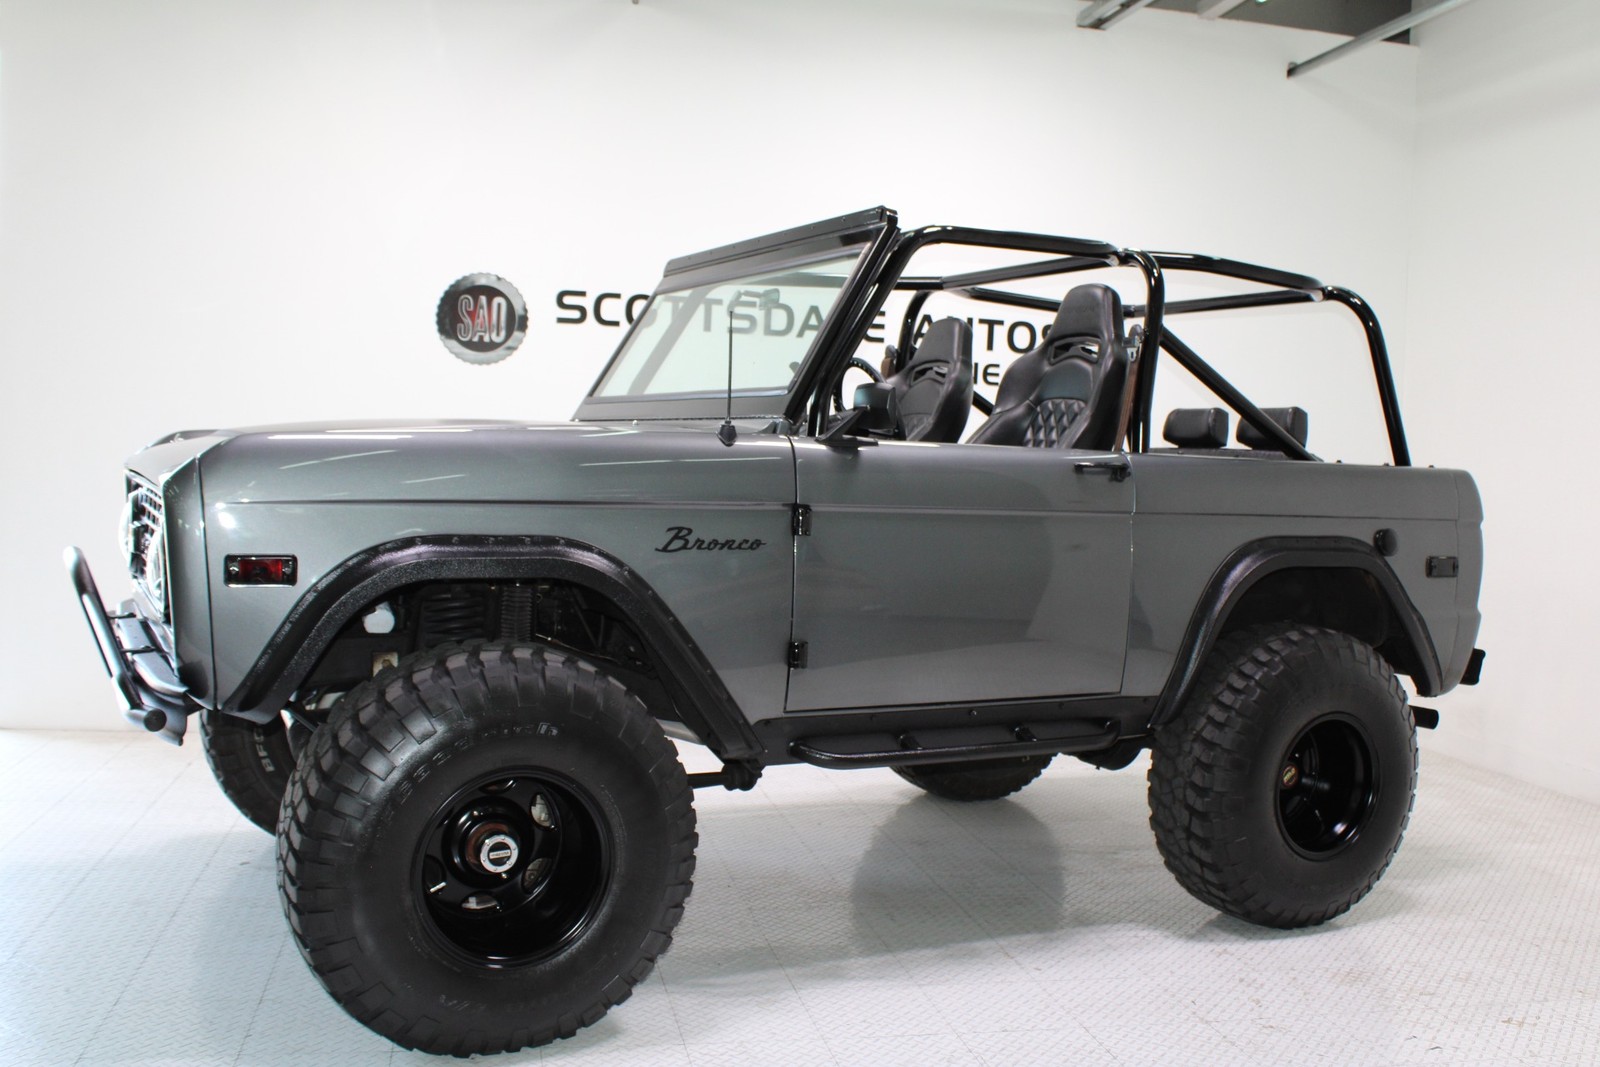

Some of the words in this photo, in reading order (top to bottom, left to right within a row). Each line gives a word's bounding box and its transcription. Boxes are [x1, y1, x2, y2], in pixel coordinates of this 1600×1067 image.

[456, 293, 508, 344] SAO
[556, 290, 886, 343] SCOTTSDAE
[654, 526, 767, 553] Bronco
